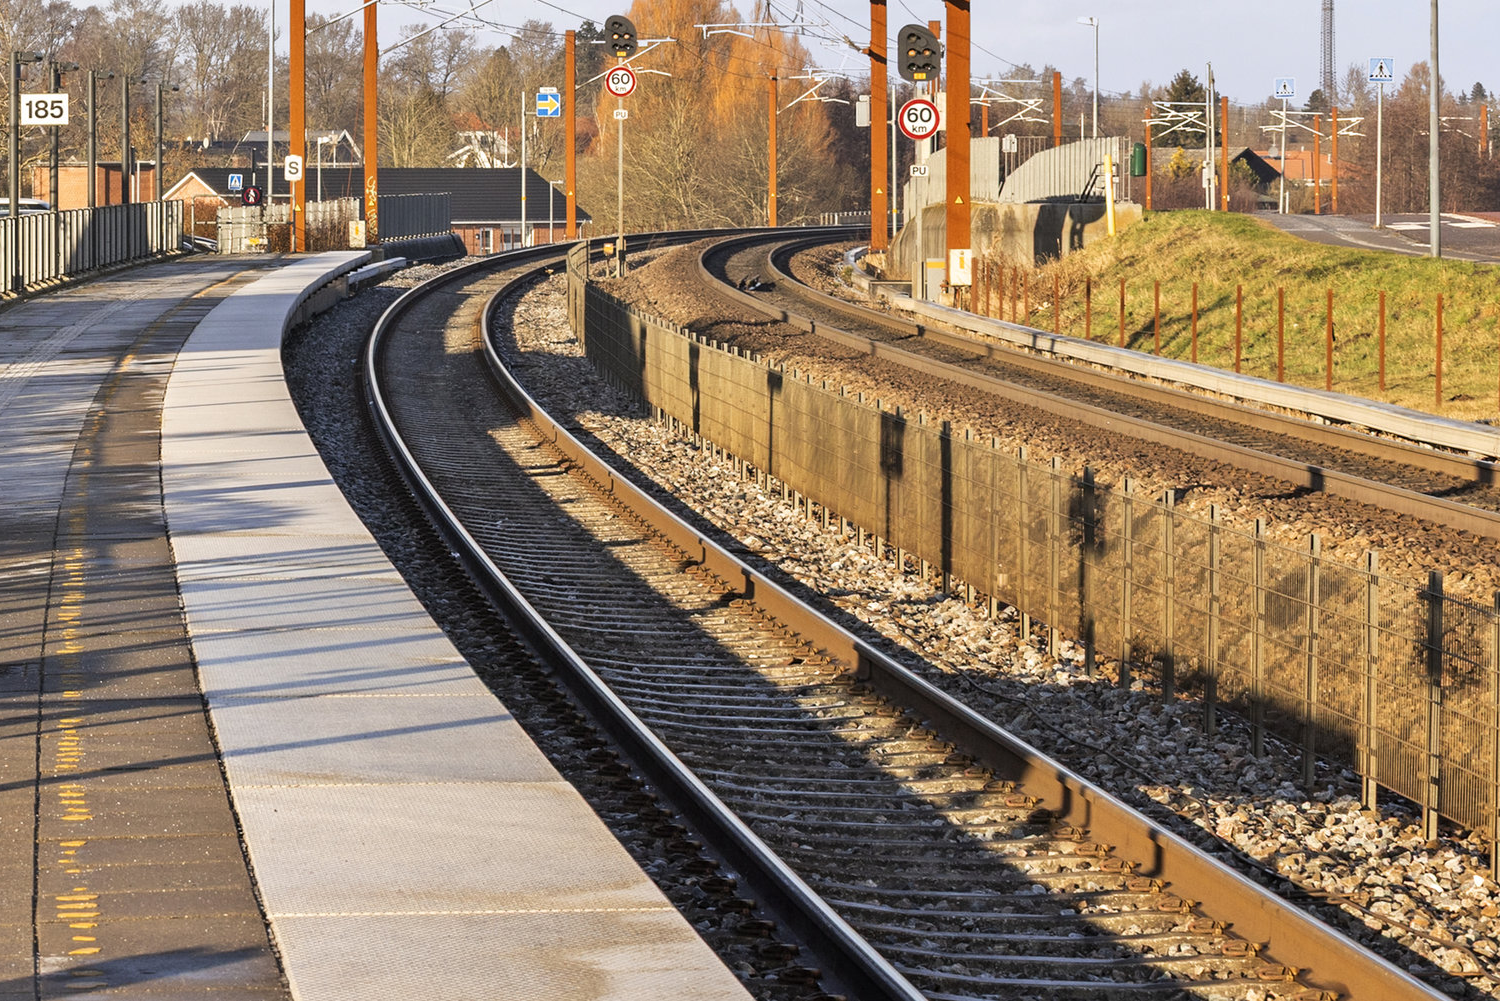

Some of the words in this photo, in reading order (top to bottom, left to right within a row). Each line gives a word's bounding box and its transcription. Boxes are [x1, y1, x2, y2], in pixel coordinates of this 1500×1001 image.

[611, 73, 630, 85] 60
[25, 100, 64, 118] 185
[907, 107, 932, 123] 60
[911, 124, 927, 133] km
[288, 161, 299, 175] S
[912, 166, 926, 175] PU
